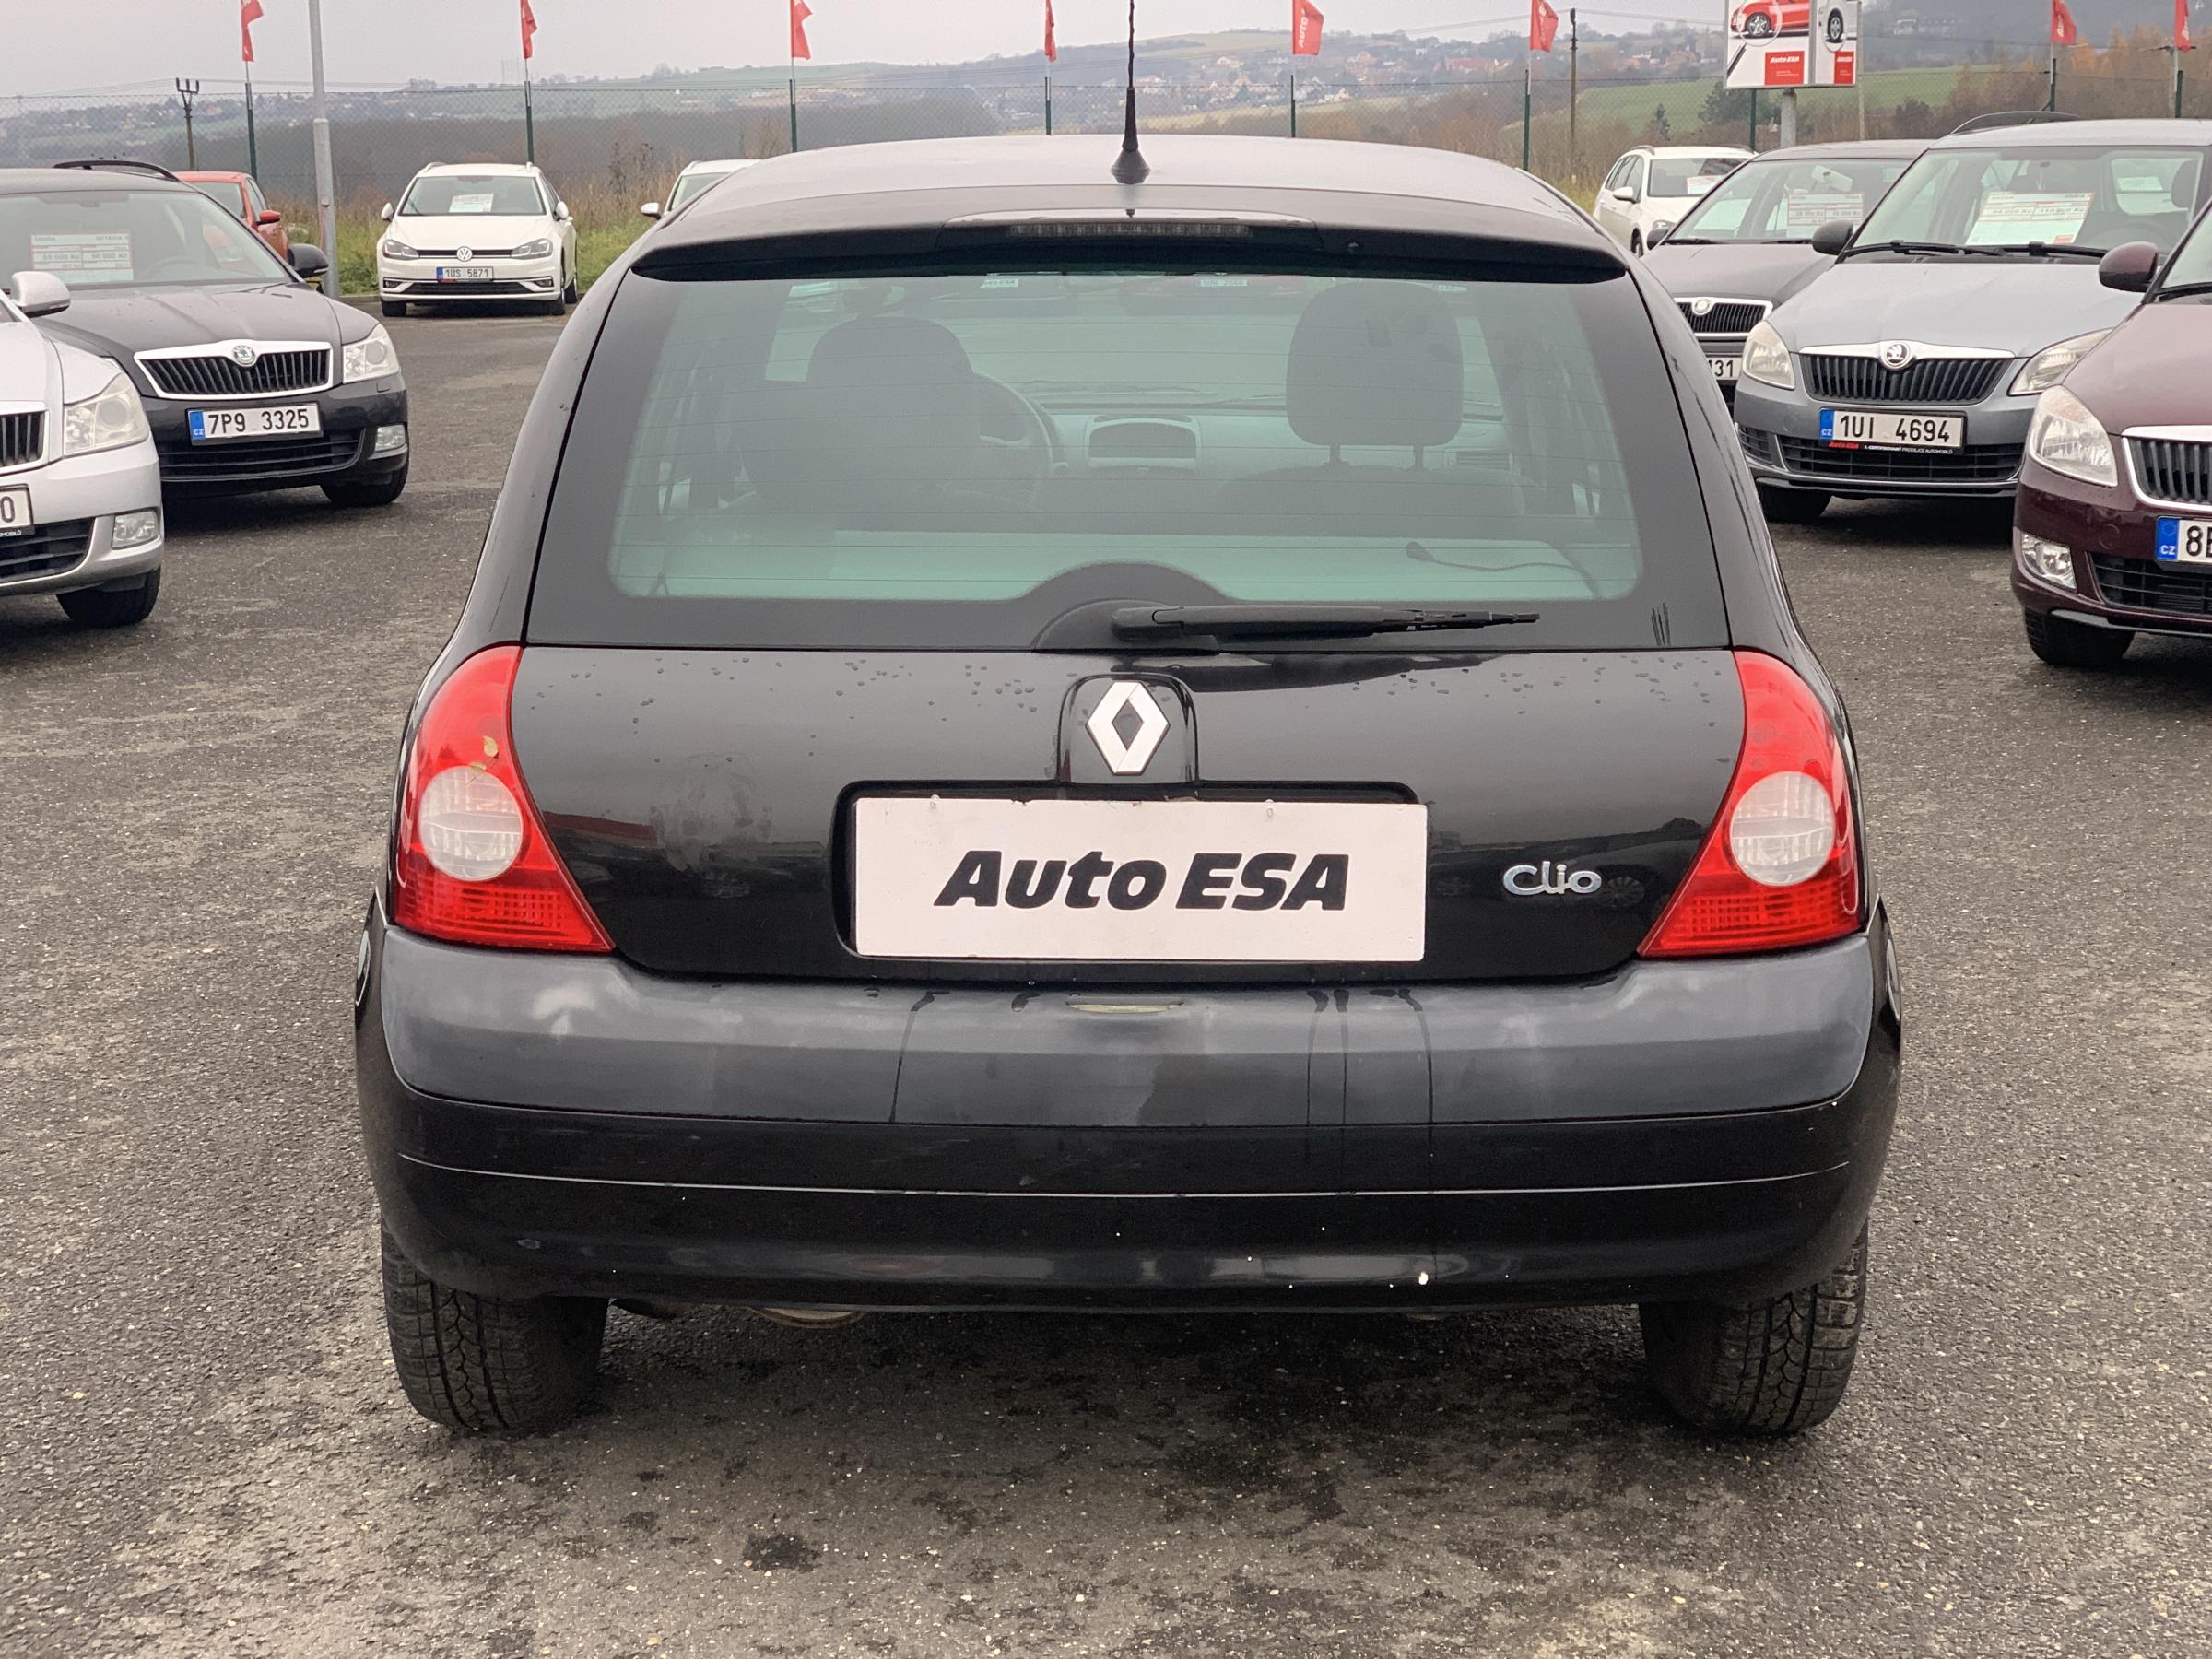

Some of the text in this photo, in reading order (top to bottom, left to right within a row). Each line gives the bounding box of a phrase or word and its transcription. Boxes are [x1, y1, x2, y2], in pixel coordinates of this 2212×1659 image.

[445, 268, 488, 277] 1US 5871
[208, 409, 309, 434] 7P9 3325
[1840, 416, 1950, 442] 1UI 4694
[2160, 545, 2176, 555] CZ
[935, 850, 1349, 911] Auto ESA
[1502, 860, 1602, 896] Clio
